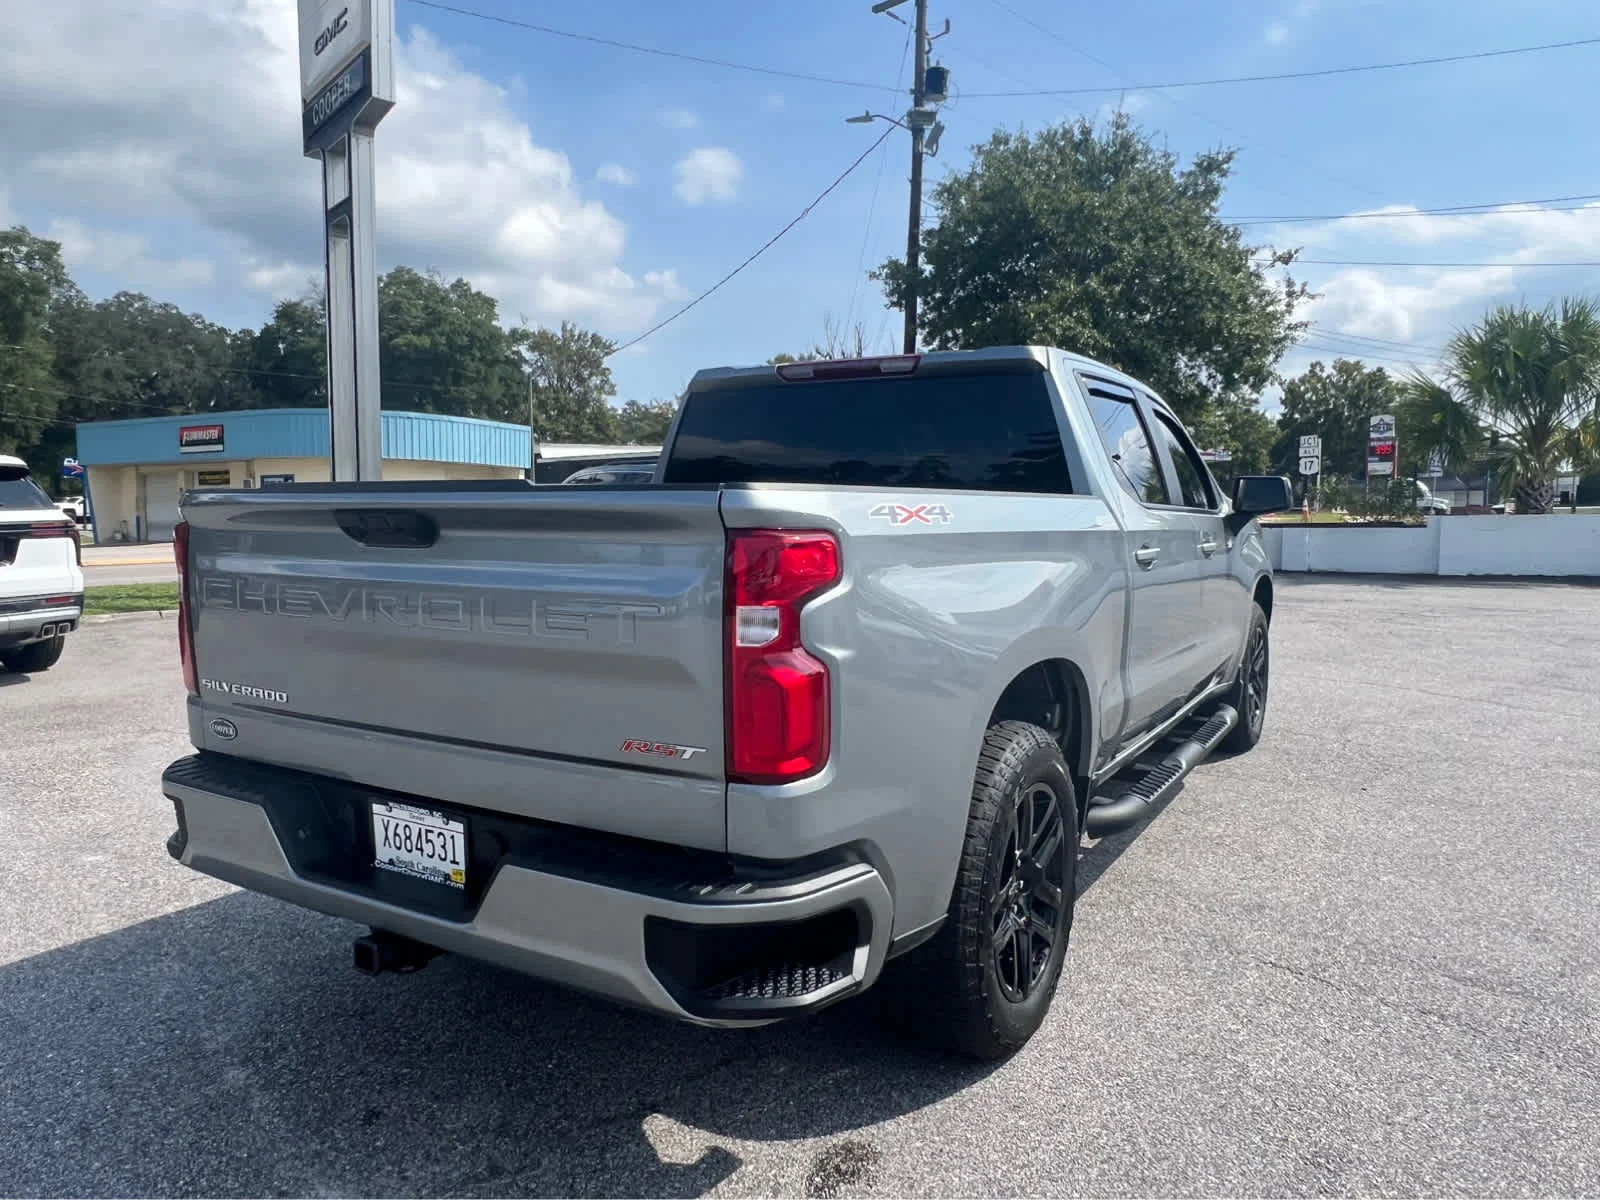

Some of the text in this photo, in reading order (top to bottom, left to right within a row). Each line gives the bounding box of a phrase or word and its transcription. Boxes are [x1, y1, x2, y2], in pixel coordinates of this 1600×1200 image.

[314, 7, 348, 56] GMC
[312, 74, 351, 126] COOPER
[1304, 460, 1314, 471] 17
[201, 576, 664, 646] CHEVROLET
[202, 679, 289, 703] SILVERADO
[621, 739, 708, 761] RST
[381, 818, 460, 866] X684531
